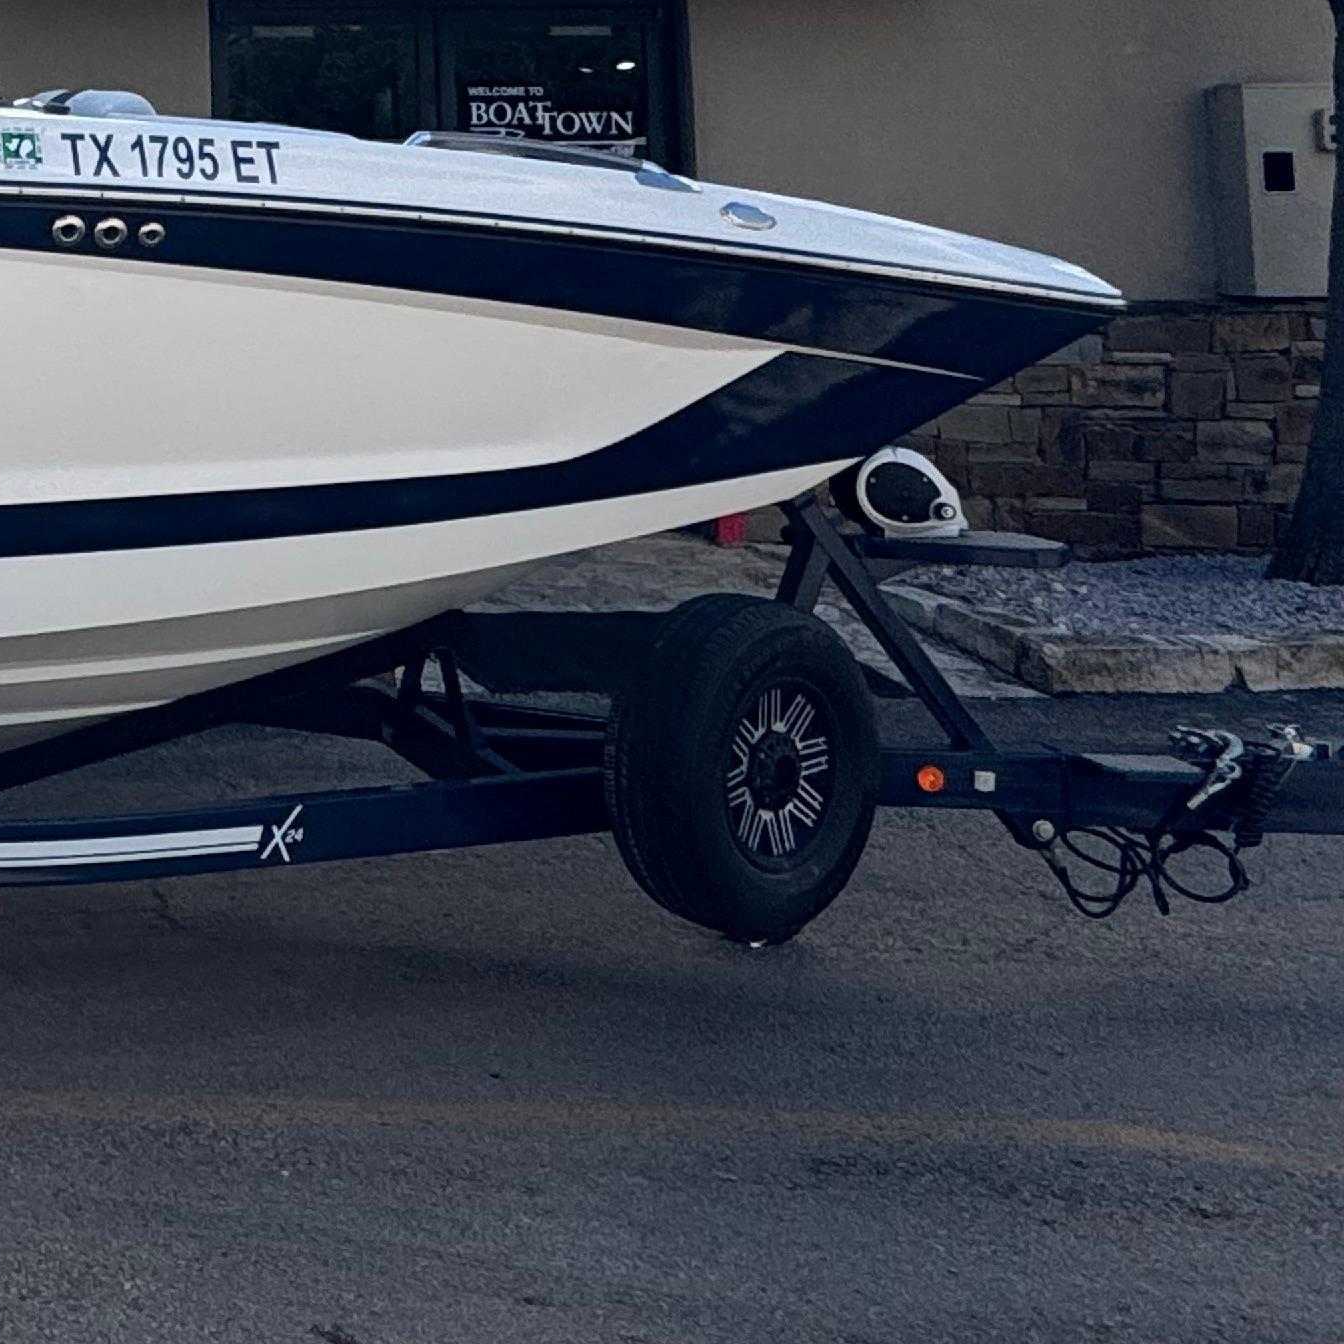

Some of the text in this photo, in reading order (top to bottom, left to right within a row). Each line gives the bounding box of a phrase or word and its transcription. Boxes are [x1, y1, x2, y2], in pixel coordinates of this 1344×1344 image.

[466, 86, 545, 97] WELCOME TO
[469, 100, 633, 136] BOAT TOWN
[61, 132, 281, 185] TX 1795 ET
